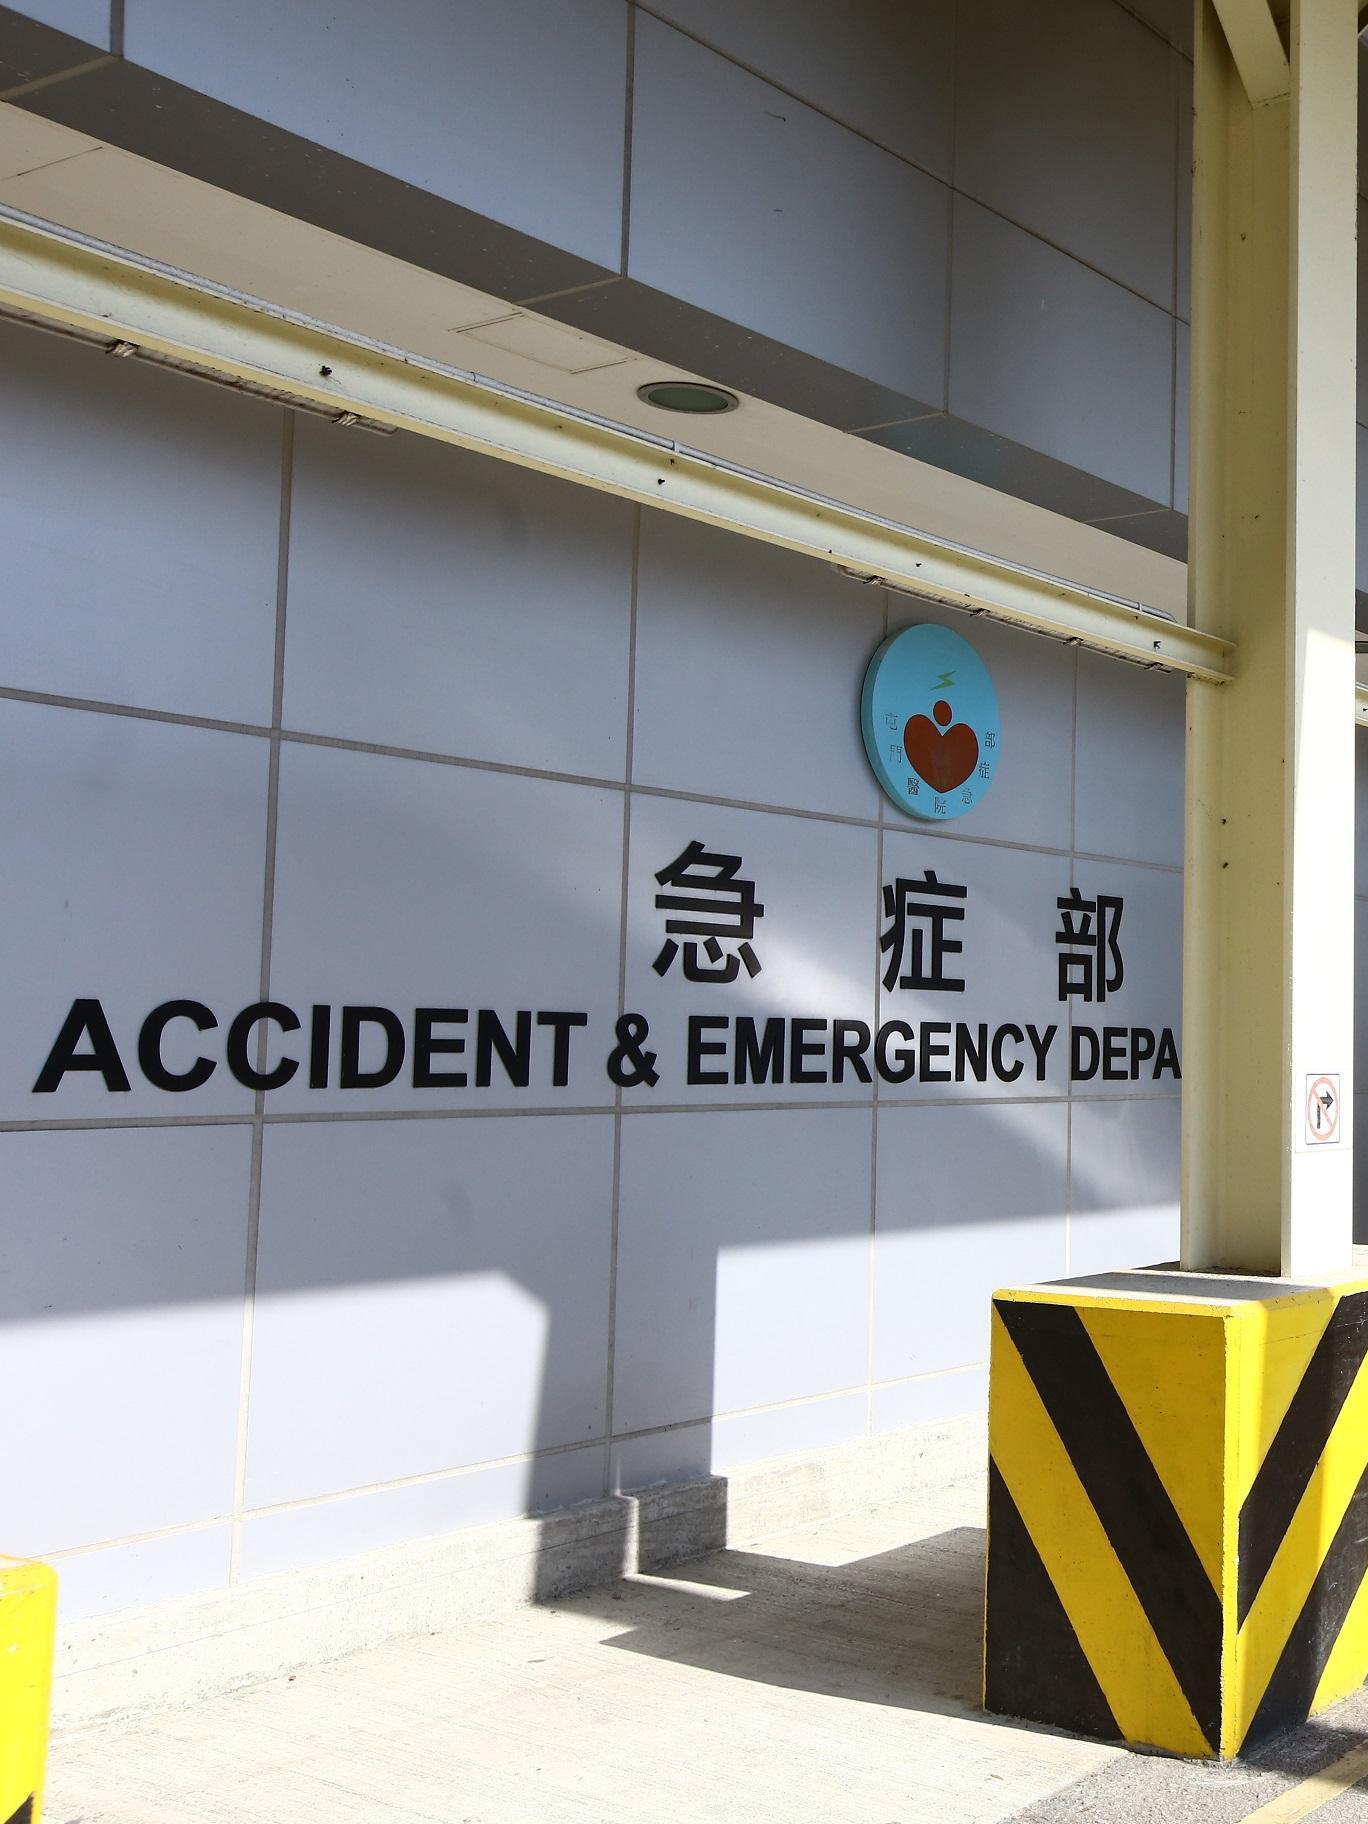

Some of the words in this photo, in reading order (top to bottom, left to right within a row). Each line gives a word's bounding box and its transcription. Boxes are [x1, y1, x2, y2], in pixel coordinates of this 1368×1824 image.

[653, 840, 1124, 1003] 急症部
[32, 998, 588, 1093] ACCIDENT
[607, 1012, 661, 1088] &
[687, 1015, 1058, 1086] EMERGENCY
[1070, 1025, 1183, 1081] DEPA
